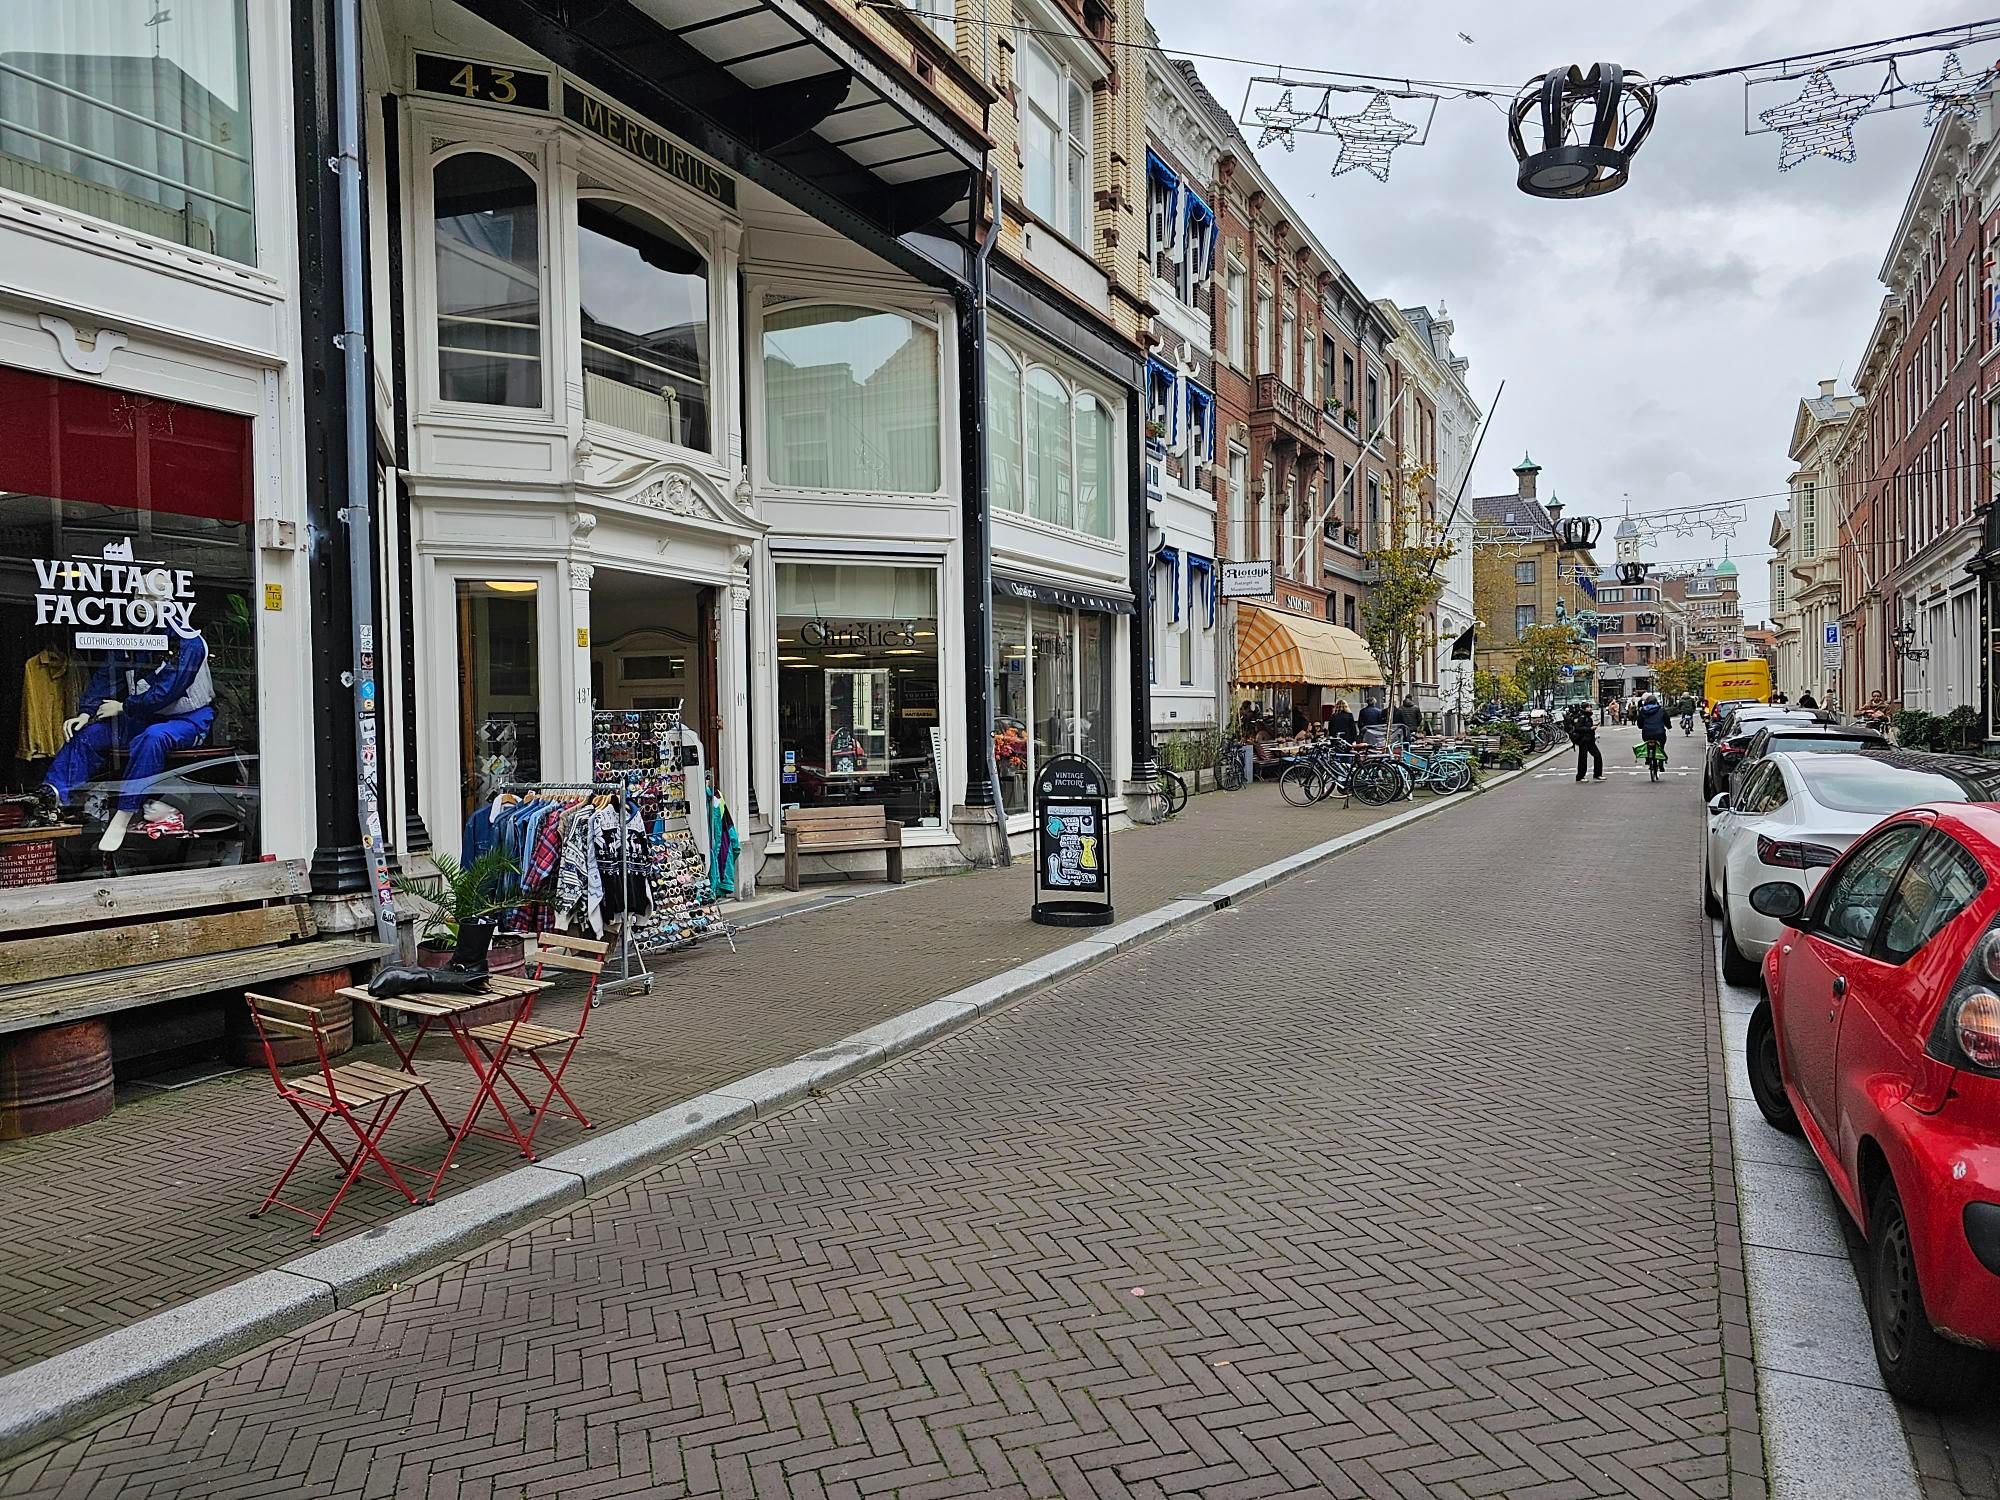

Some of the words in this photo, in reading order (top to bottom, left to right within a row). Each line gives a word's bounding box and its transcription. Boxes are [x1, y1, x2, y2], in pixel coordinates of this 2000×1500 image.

[449, 63, 517, 103] 43
[582, 94, 721, 200] MERCURIUS
[31, 558, 196, 600] VINTAGE
[34, 593, 201, 639] FACTORY
[79, 636, 115, 647] CLOTHING,
[116, 637, 138, 647] BOOTS
[139, 638, 145, 647] &
[145, 638, 165, 648] MORE
[801, 620, 916, 647] Christie's
[1055, 771, 1084, 779] VINTAGE
[1055, 779, 1085, 788] FACTORY
